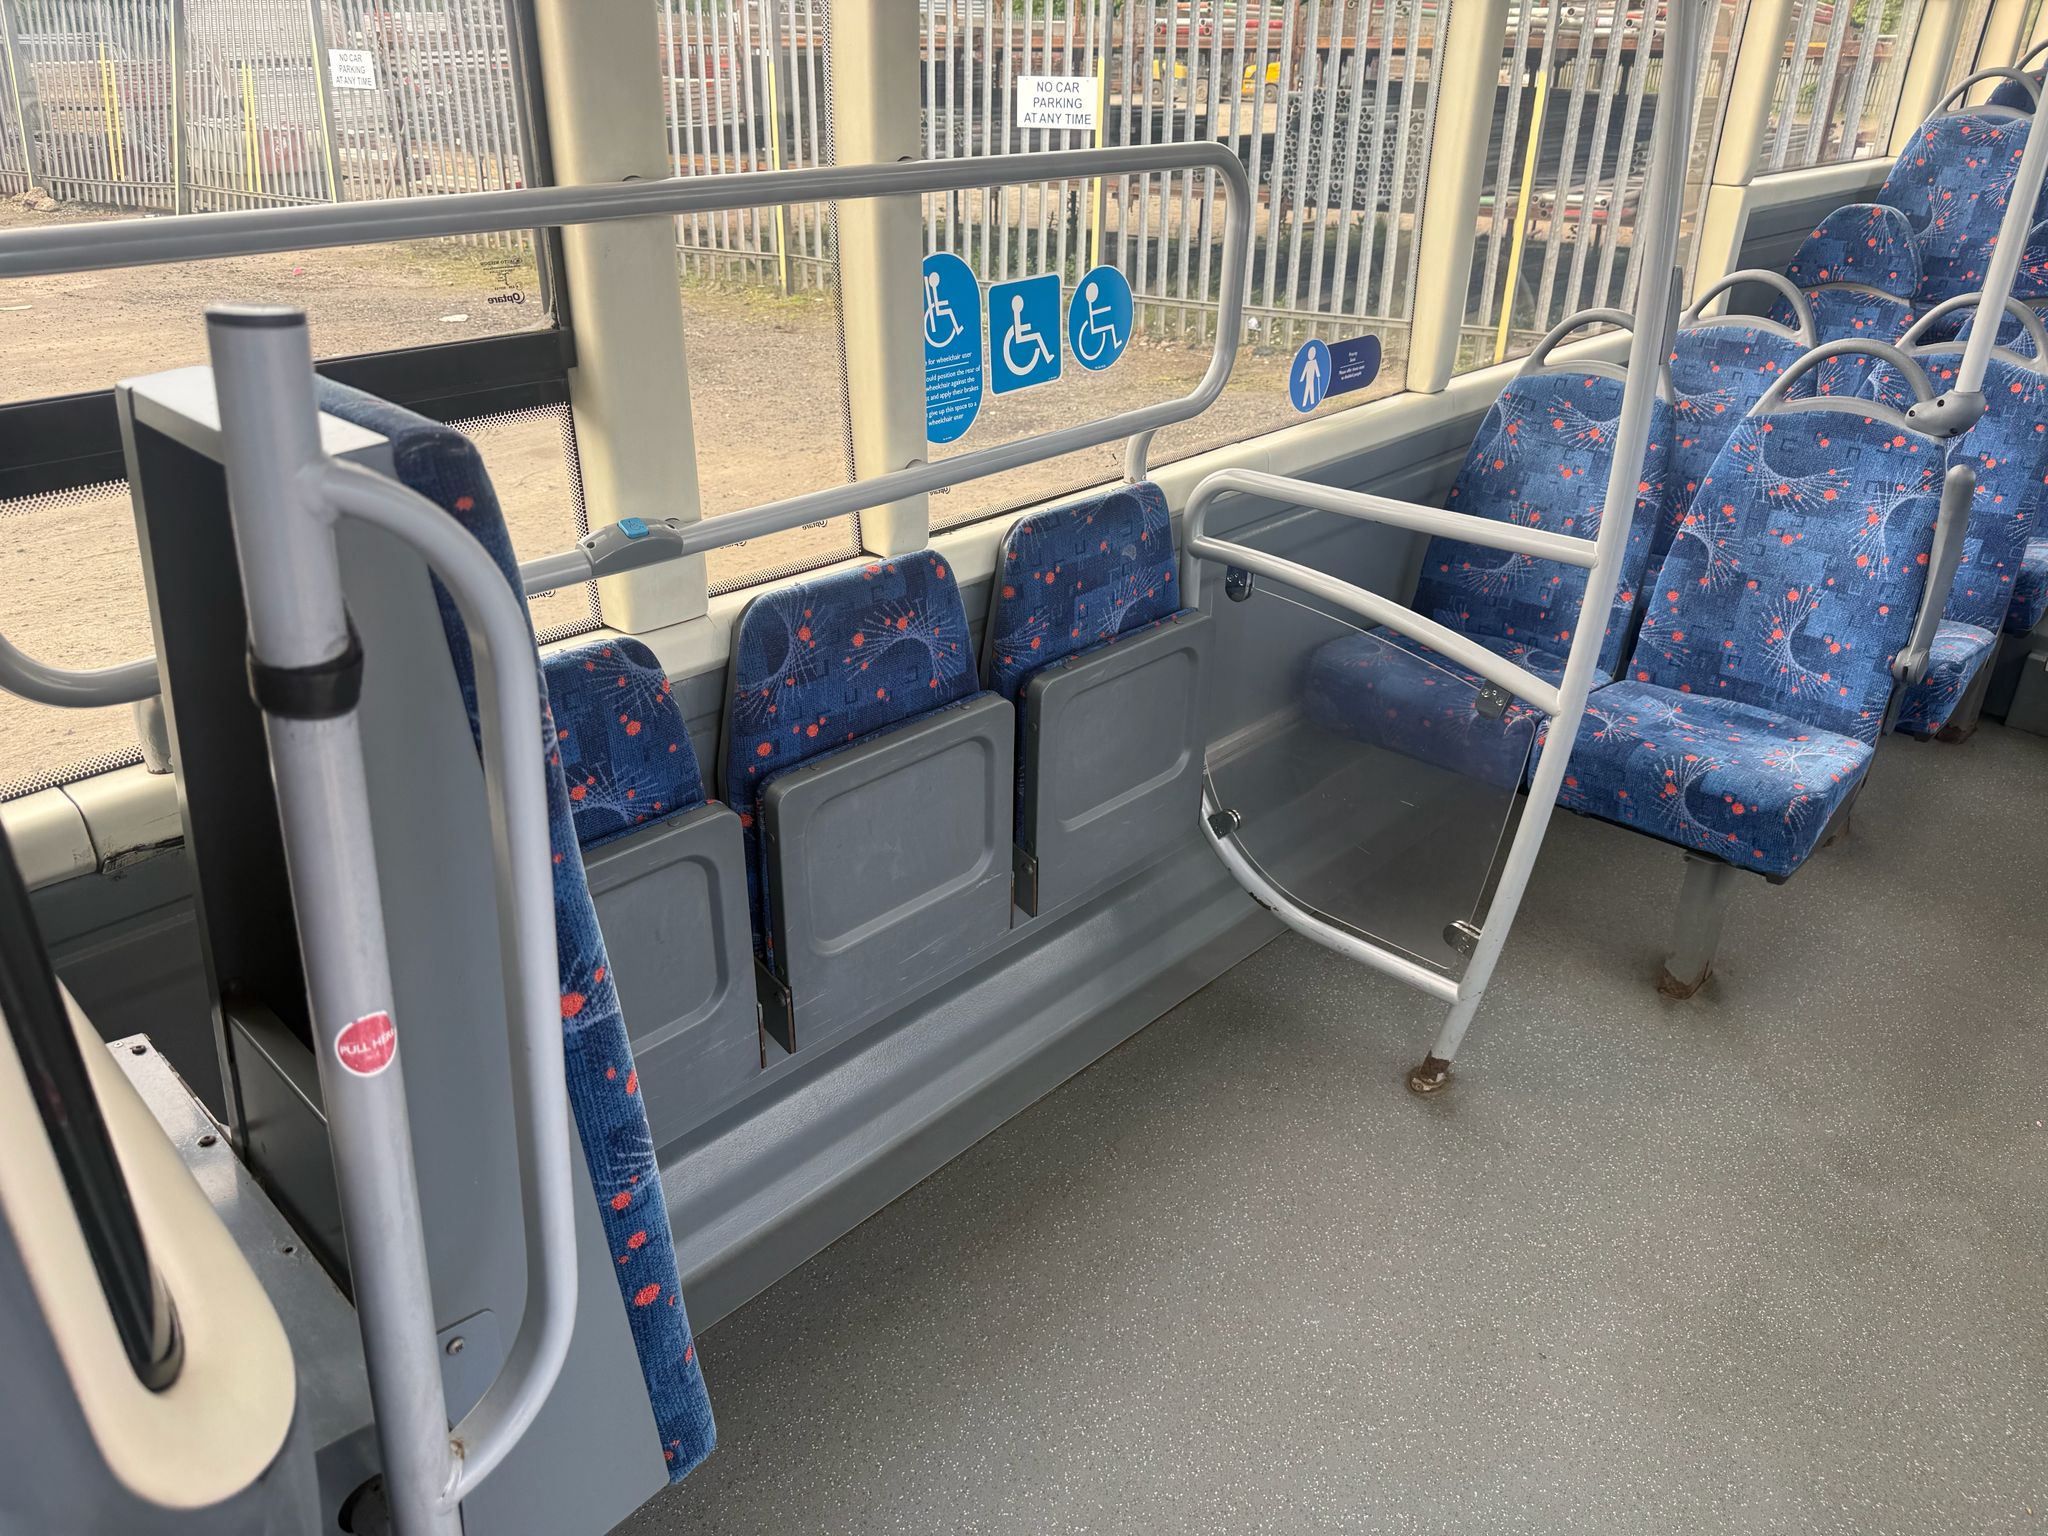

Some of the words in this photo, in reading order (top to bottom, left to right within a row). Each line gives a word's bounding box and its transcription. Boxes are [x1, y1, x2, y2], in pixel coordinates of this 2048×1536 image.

[339, 53, 348, 62] NO
[349, 53, 362, 63] CAR
[339, 64, 366, 74] PARKING
[336, 76, 343, 84] AT
[344, 76, 356, 85] ANY
[357, 77, 372, 86] TIME
[1036, 81, 1053, 93] NO
[1055, 81, 1080, 93] CAR
[1033, 97, 1083, 109] PARKING
[1024, 112, 1037, 123] AT
[1039, 113, 1062, 124] ANY
[1065, 114, 1092, 125] TIME
[936, 353, 961, 363] wheelchair
[961, 351, 972, 359] user
[937, 371, 956, 382] position
[951, 378, 967, 388] against
[939, 390, 952, 400] apply
[963, 385, 979, 393] brakes
[954, 403, 968, 412] space
[928, 415, 953, 426] wheelchair
[340, 1042, 371, 1056] PULL
